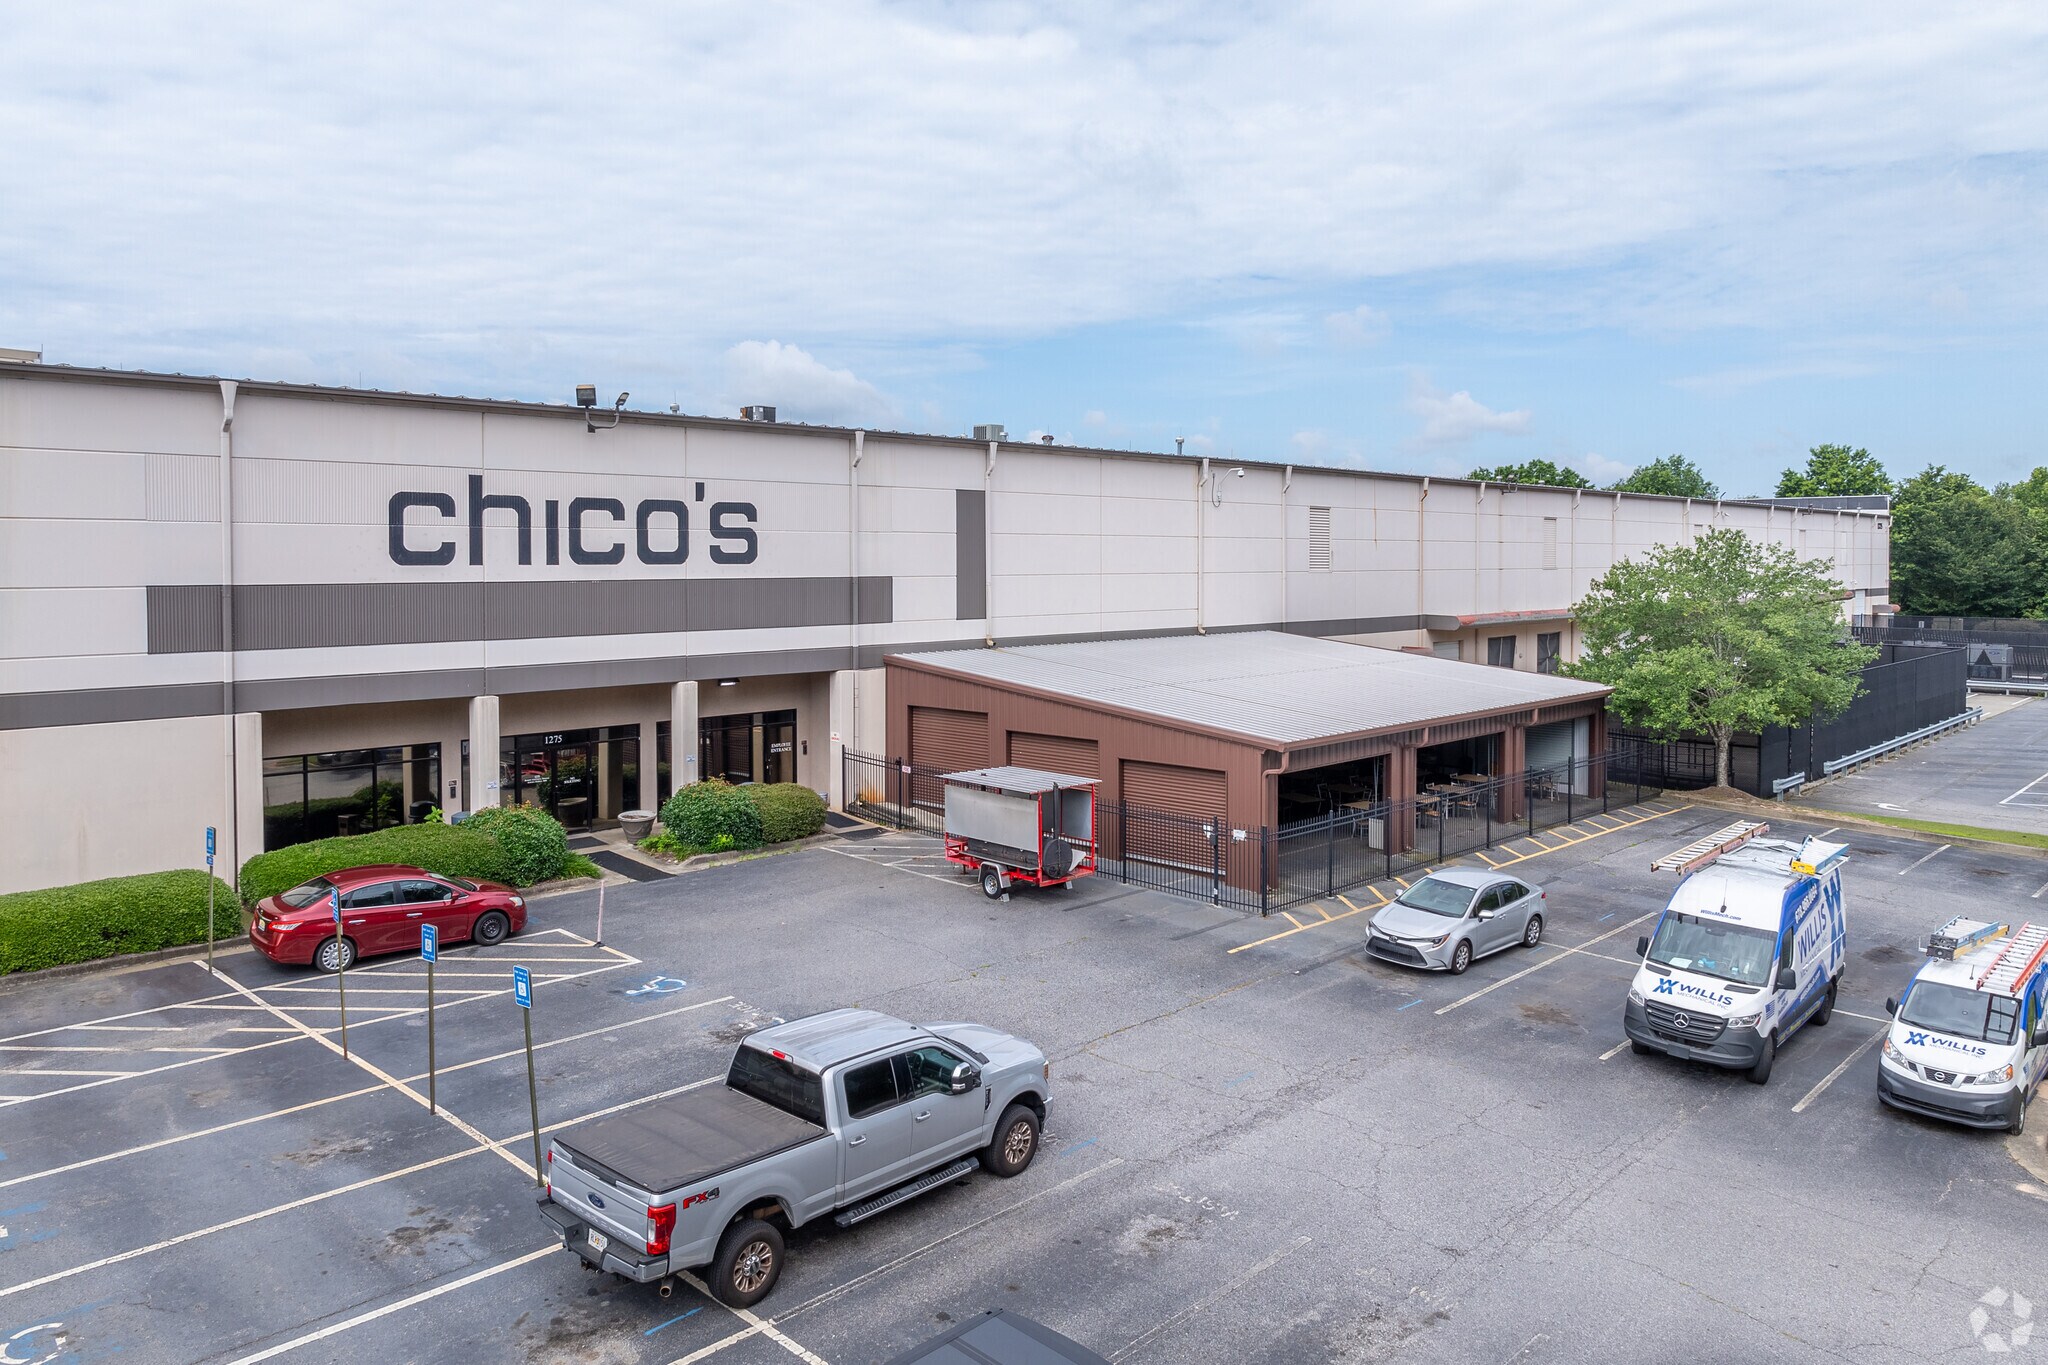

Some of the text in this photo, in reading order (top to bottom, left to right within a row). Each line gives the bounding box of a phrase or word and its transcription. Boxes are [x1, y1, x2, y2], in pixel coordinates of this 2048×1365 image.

[388, 474, 758, 566] chico's
[544, 734, 563, 744] 1275
[1797, 902, 1827, 964] WILLIS
[1677, 991, 1716, 1005] MECHANICAL
[1680, 983, 1733, 1006] WILLIS
[1931, 1037, 1987, 1056] WILLIS
[682, 1186, 720, 1210] FX4
